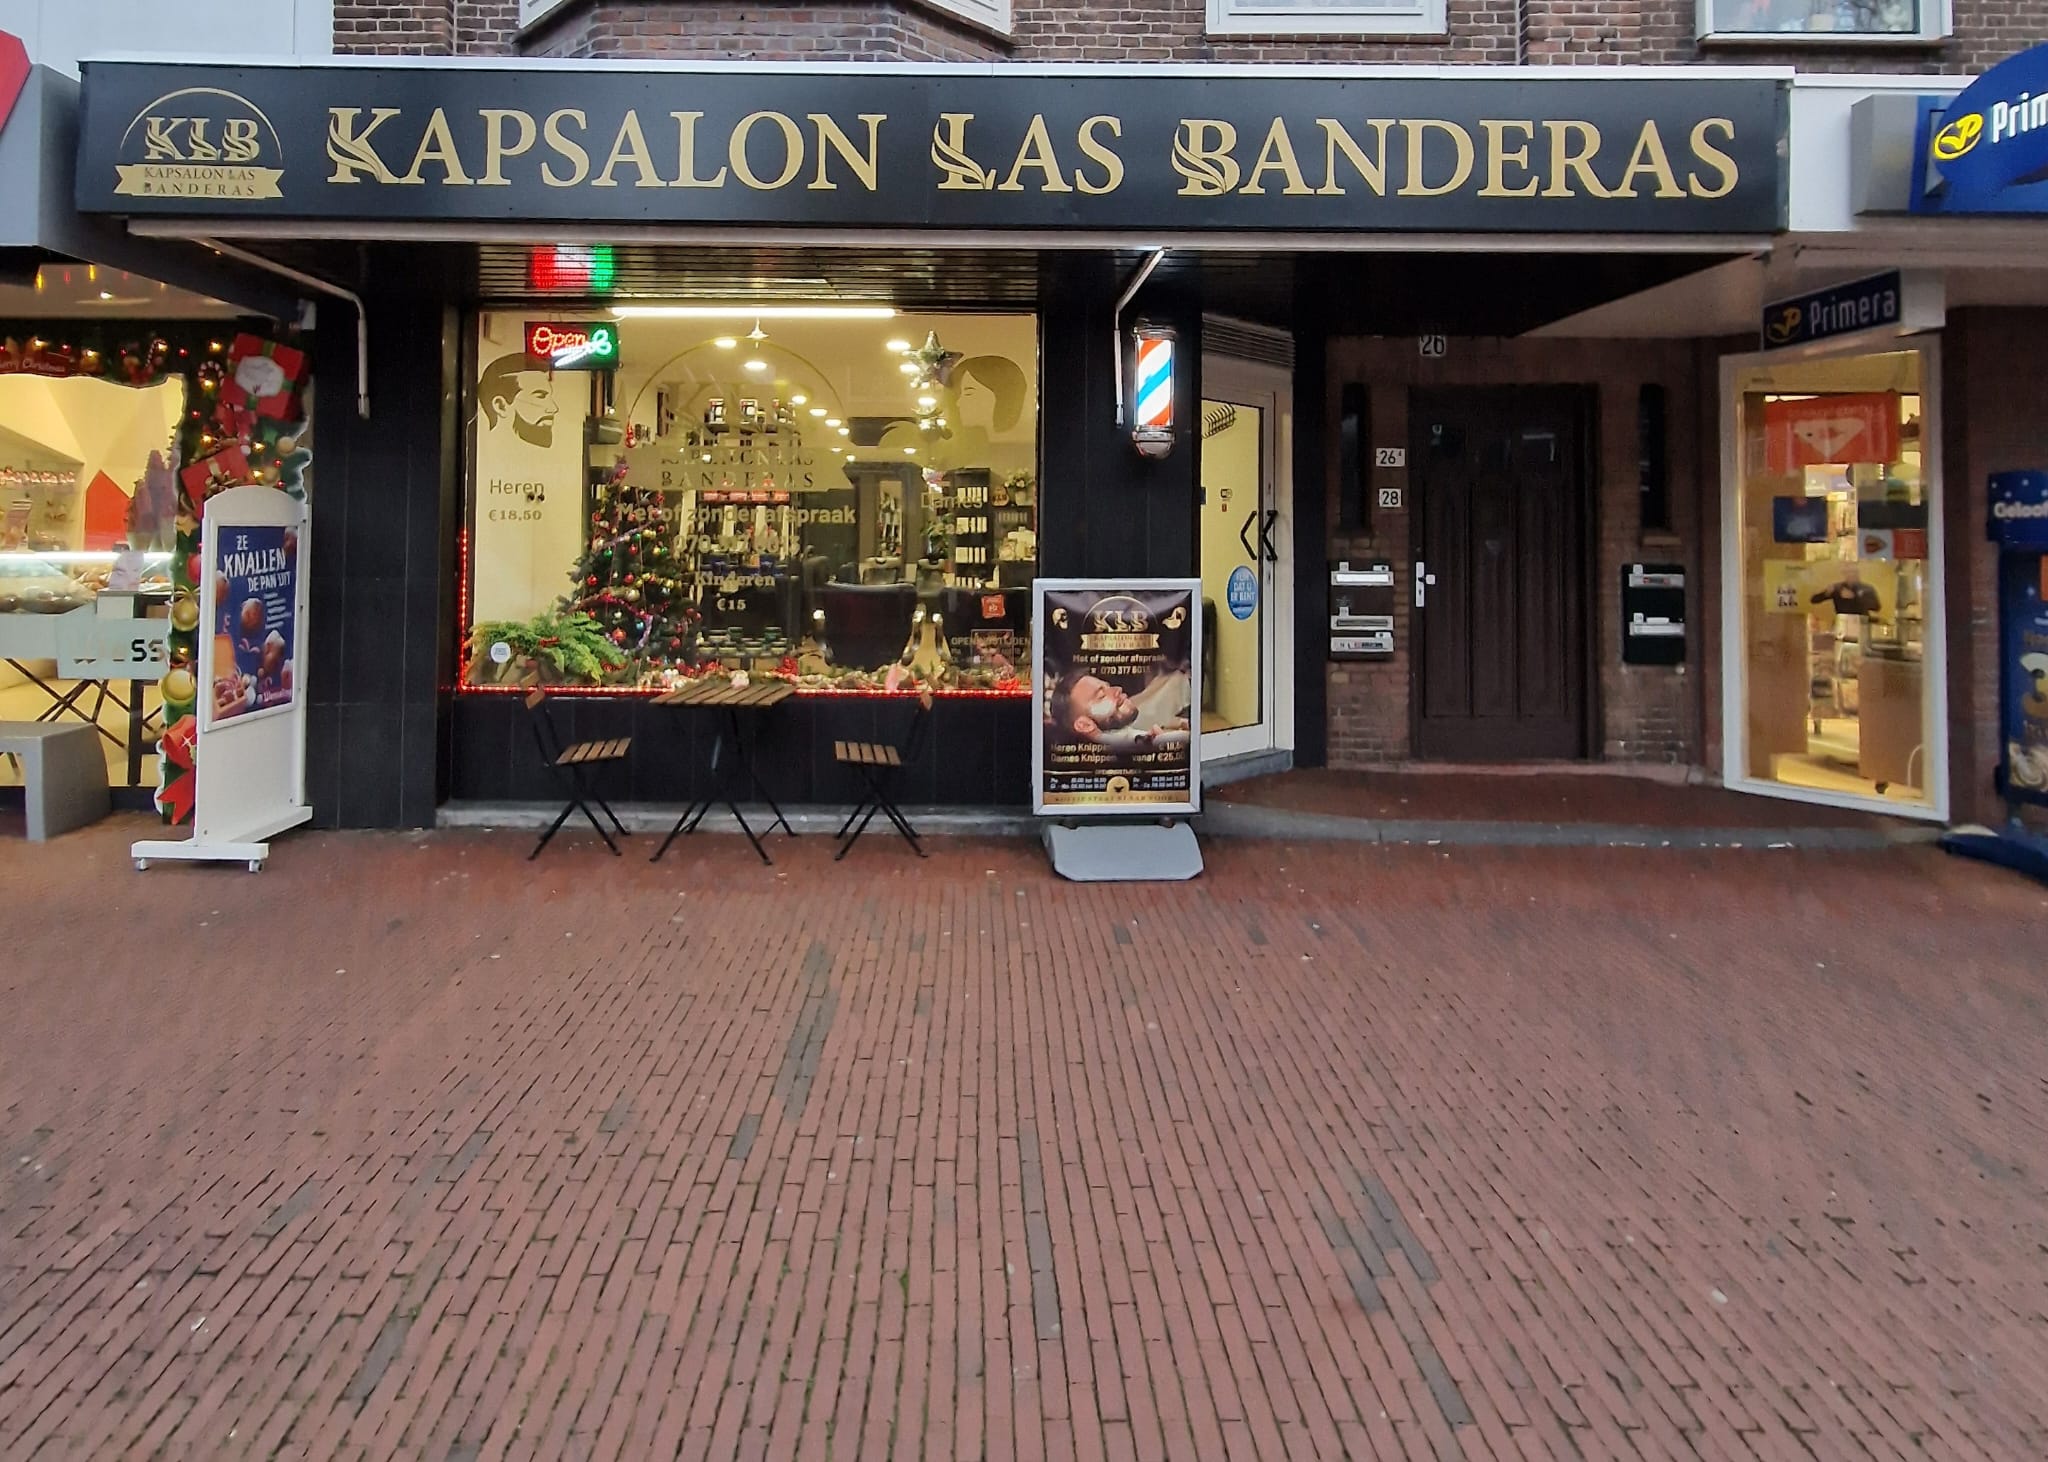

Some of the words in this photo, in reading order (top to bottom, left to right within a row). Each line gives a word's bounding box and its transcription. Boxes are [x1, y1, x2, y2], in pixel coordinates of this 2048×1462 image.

[144, 116, 260, 162] KLB
[327, 107, 887, 191] KAPSALON
[931, 112, 1125, 195] LAS
[1171, 116, 1740, 199] BANDERAS
[144, 167, 223, 180] KAPSALON
[227, 169, 255, 181] LAS
[144, 182, 255, 196] BANDERAS
[1810, 289, 1896, 335] Primera
[532, 326, 586, 355] Open
[1420, 335, 1445, 355] 26
[489, 479, 545, 495] Heren
[1381, 490, 1399, 505] 28
[617, 503, 657, 522] Met
[661, 502, 682, 522] of
[687, 502, 762, 524] zonder
[764, 502, 856, 527] afspraak
[236, 535, 248, 550] ZE
[224, 548, 286, 578] KNALLEN
[248, 576, 259, 593] DE
[261, 574, 276, 589] PAN
[695, 571, 776, 587] Kinderen
[716, 599, 747, 612] €15
[1093, 610, 1149, 632] KLB
[1090, 654, 1099, 664] of
[1101, 654, 1129, 664] zonder
[1132, 752, 1155, 762] vanaf
